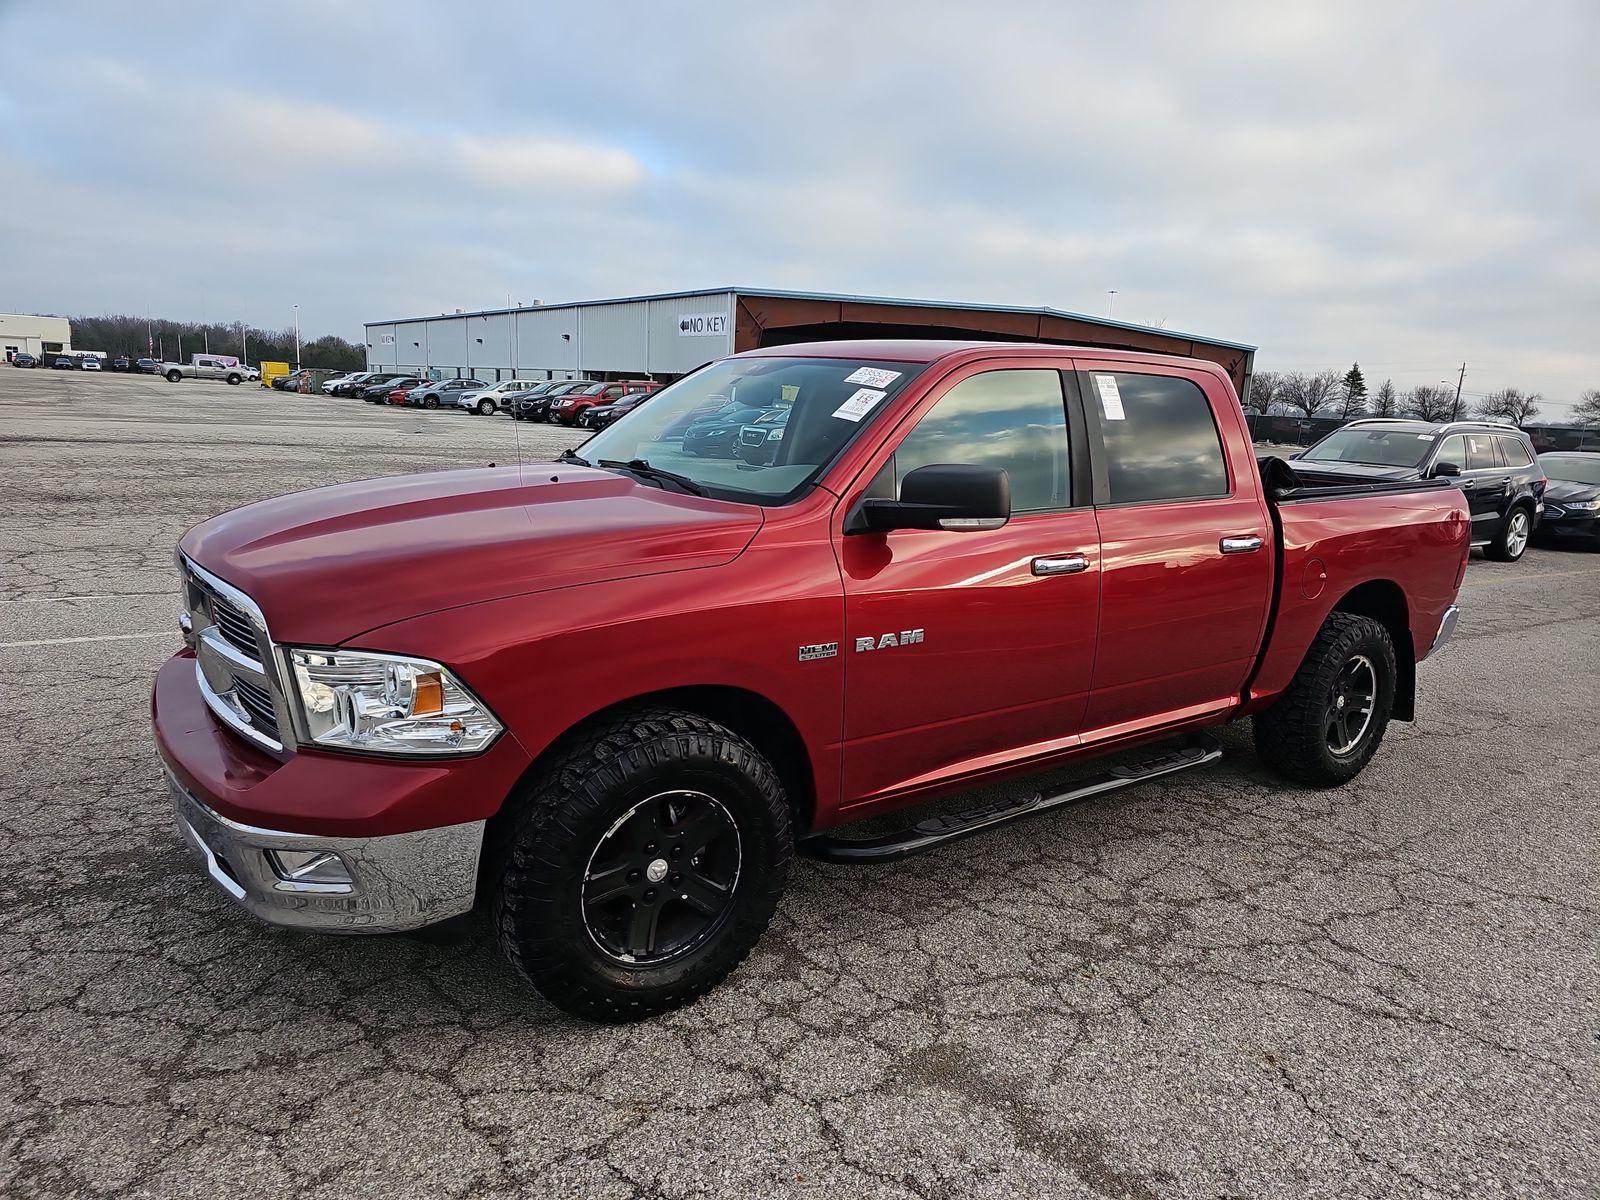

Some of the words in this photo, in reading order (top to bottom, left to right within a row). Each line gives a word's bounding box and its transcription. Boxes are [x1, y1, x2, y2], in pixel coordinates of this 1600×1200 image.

[689, 317, 703, 333] NO
[706, 316, 727, 332] KEY
[855, 628, 924, 652] RAM
[800, 643, 837, 655] HEMI
[814, 651, 836, 659] LITER
